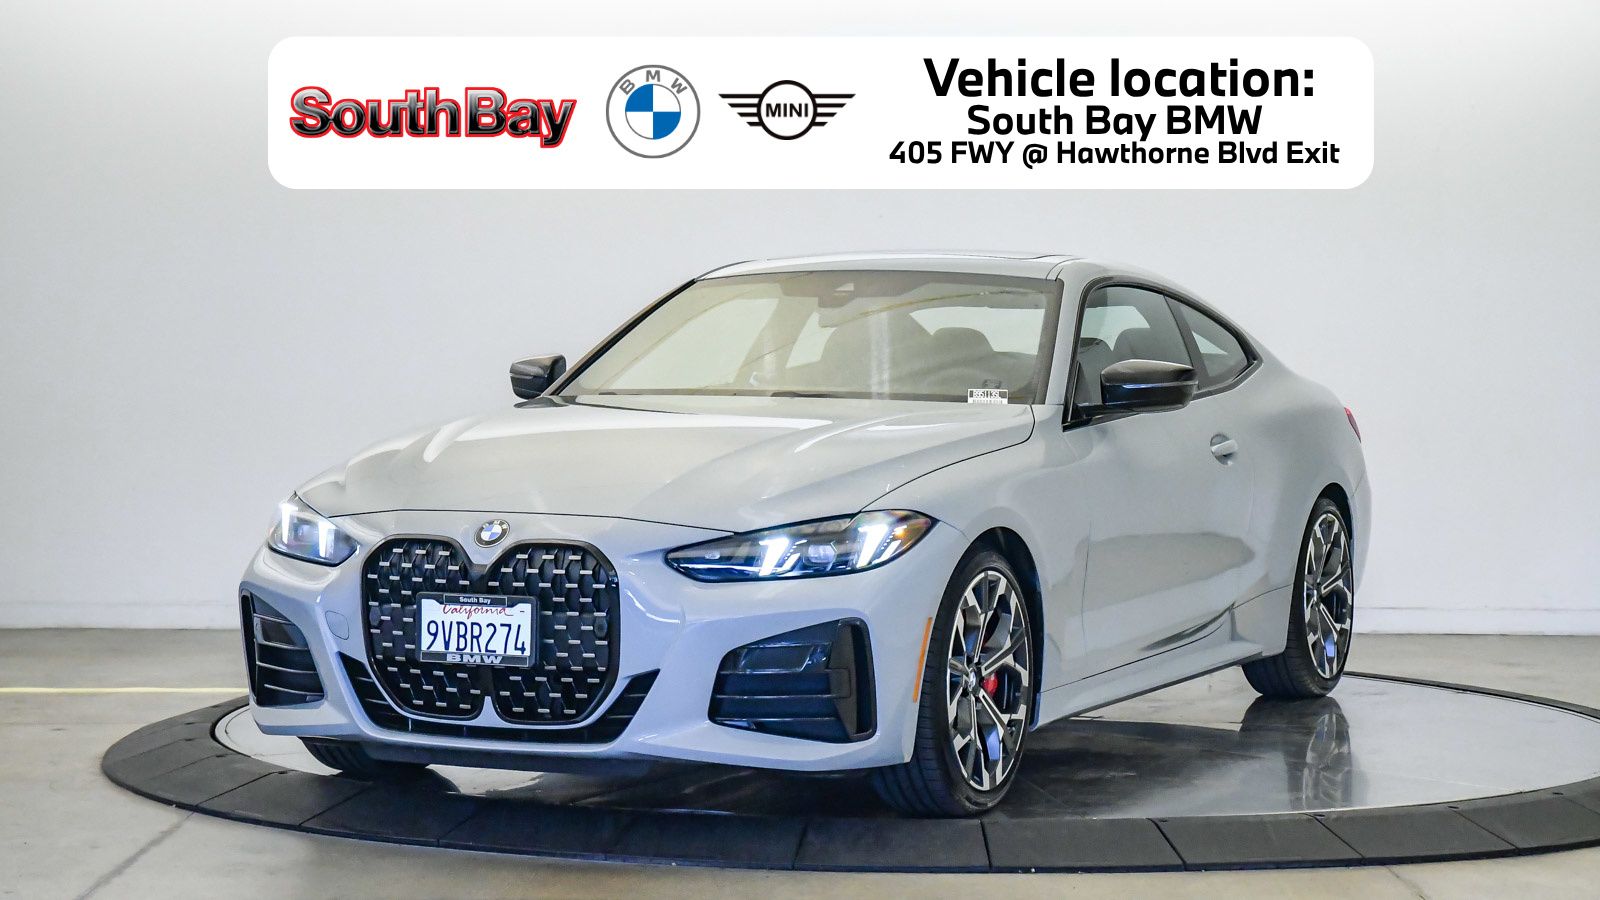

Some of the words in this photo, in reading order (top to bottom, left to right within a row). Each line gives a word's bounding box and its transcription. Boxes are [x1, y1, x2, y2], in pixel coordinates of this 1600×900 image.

[442, 604, 513, 619] California
[427, 620, 526, 654] 9VBR274
[446, 654, 503, 664] BMW
